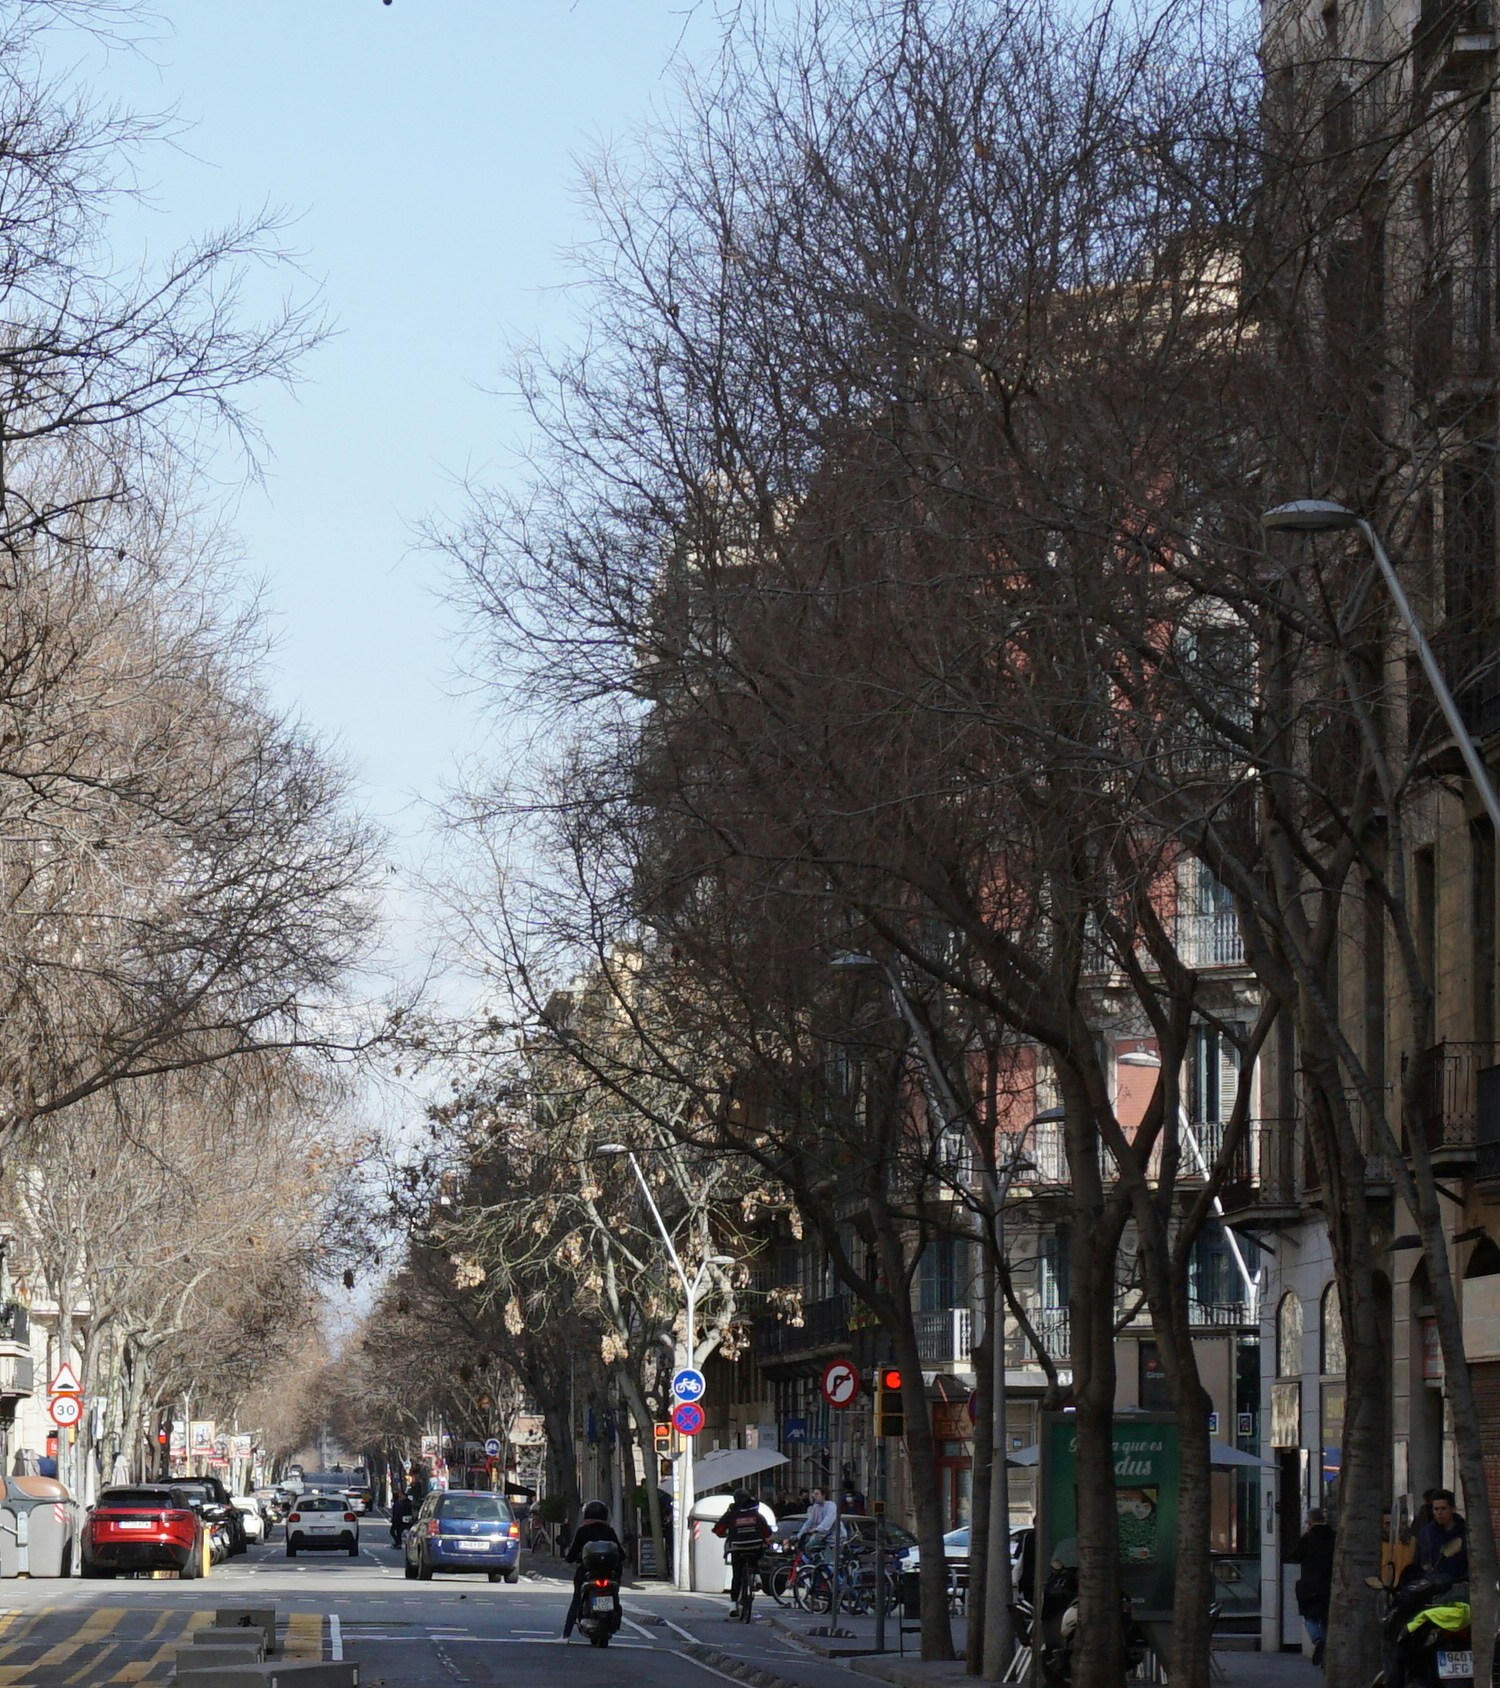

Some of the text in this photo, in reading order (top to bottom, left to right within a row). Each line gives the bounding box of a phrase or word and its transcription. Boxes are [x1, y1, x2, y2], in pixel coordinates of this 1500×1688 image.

[56, 1404, 76, 1416] 30
[787, 1428, 806, 1439] AXA
[1122, 1441, 1147, 1455] que
[1149, 1440, 1163, 1452] es
[1114, 1455, 1152, 1476] dus
